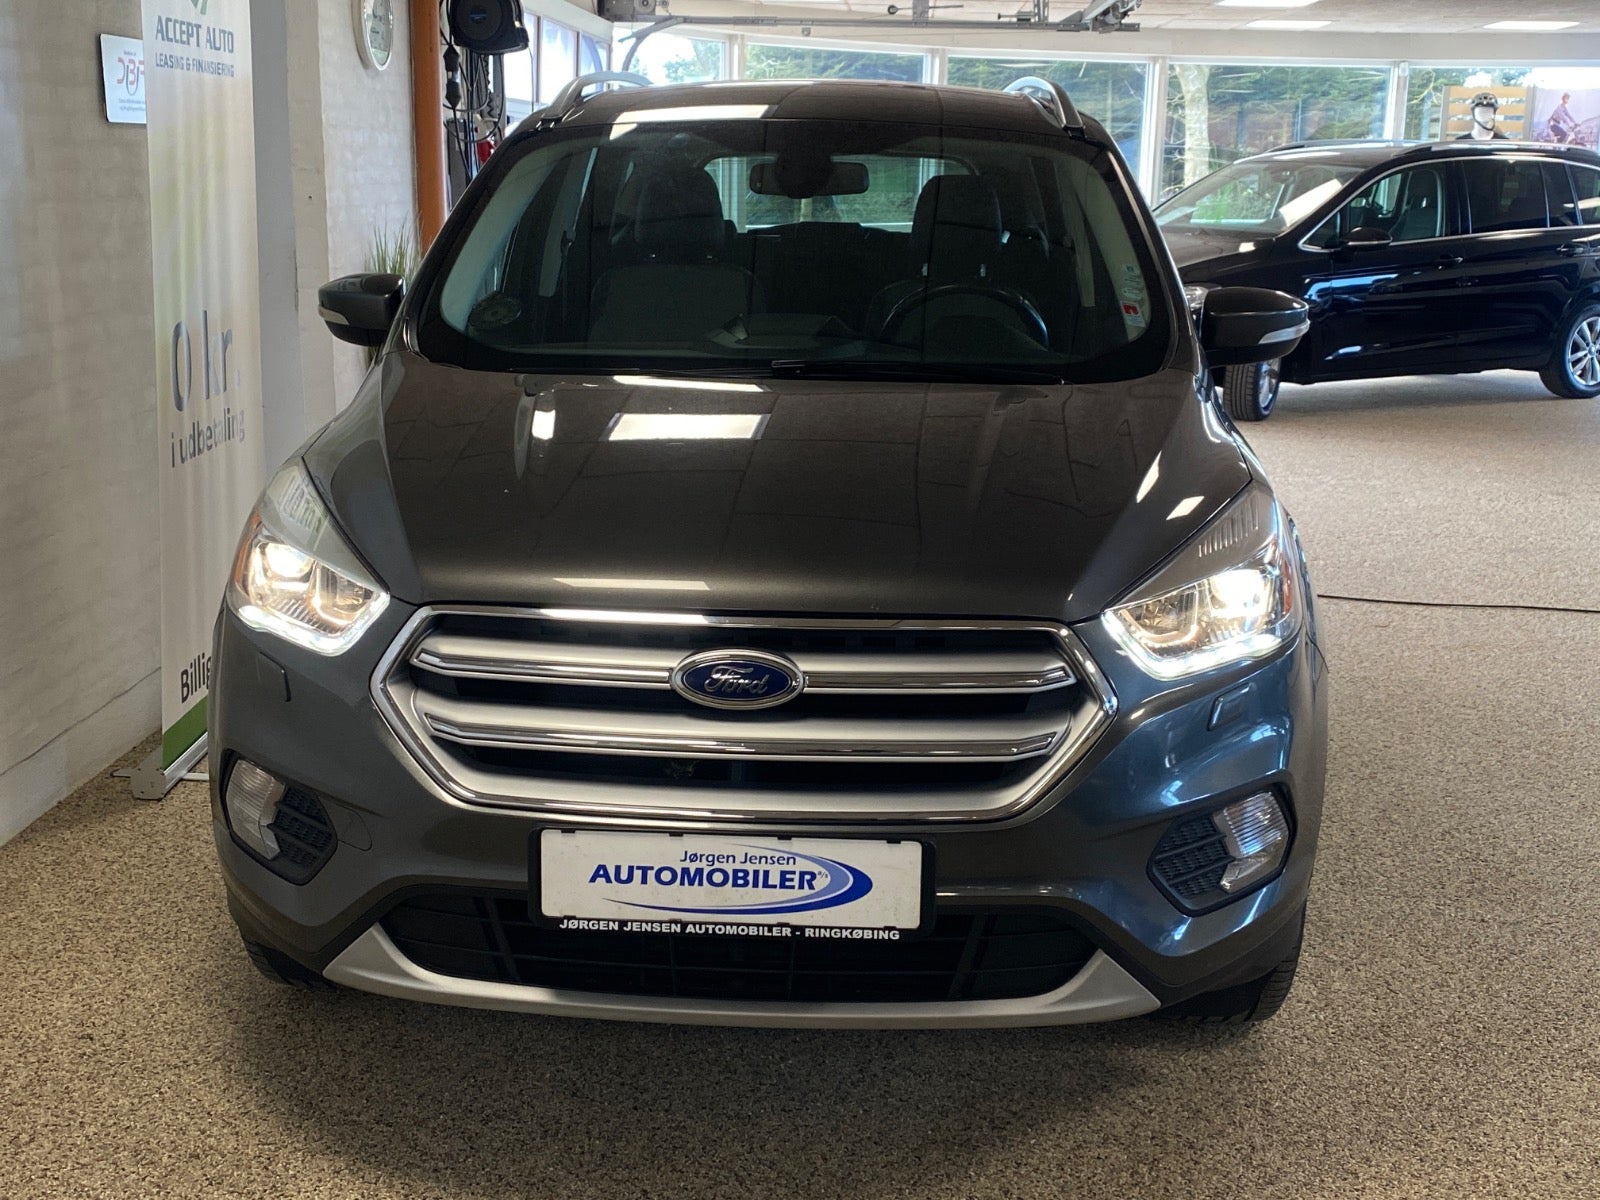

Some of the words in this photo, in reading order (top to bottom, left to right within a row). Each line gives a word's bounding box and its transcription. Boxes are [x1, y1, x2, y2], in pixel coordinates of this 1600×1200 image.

[155, 15, 202, 47] ACCEPT
[205, 26, 234, 54] AUTO
[155, 52, 184, 71] LEASING
[185, 57, 191, 71] &
[192, 58, 234, 77] FINANSIERING
[202, 310, 240, 400] kr.
[171, 432, 175, 468] i
[179, 407, 245, 464] udbetaling
[704, 665, 769, 694] Ford
[680, 850, 736, 867] Jørgen
[740, 852, 796, 866] Jensen
[588, 864, 817, 890] AUTOMOBILER
[559, 919, 619, 931] JØRGEN
[623, 921, 681, 933] JENSEN
[685, 923, 792, 937] AUTOMOBILER
[804, 927, 900, 940] RINGKØBING
